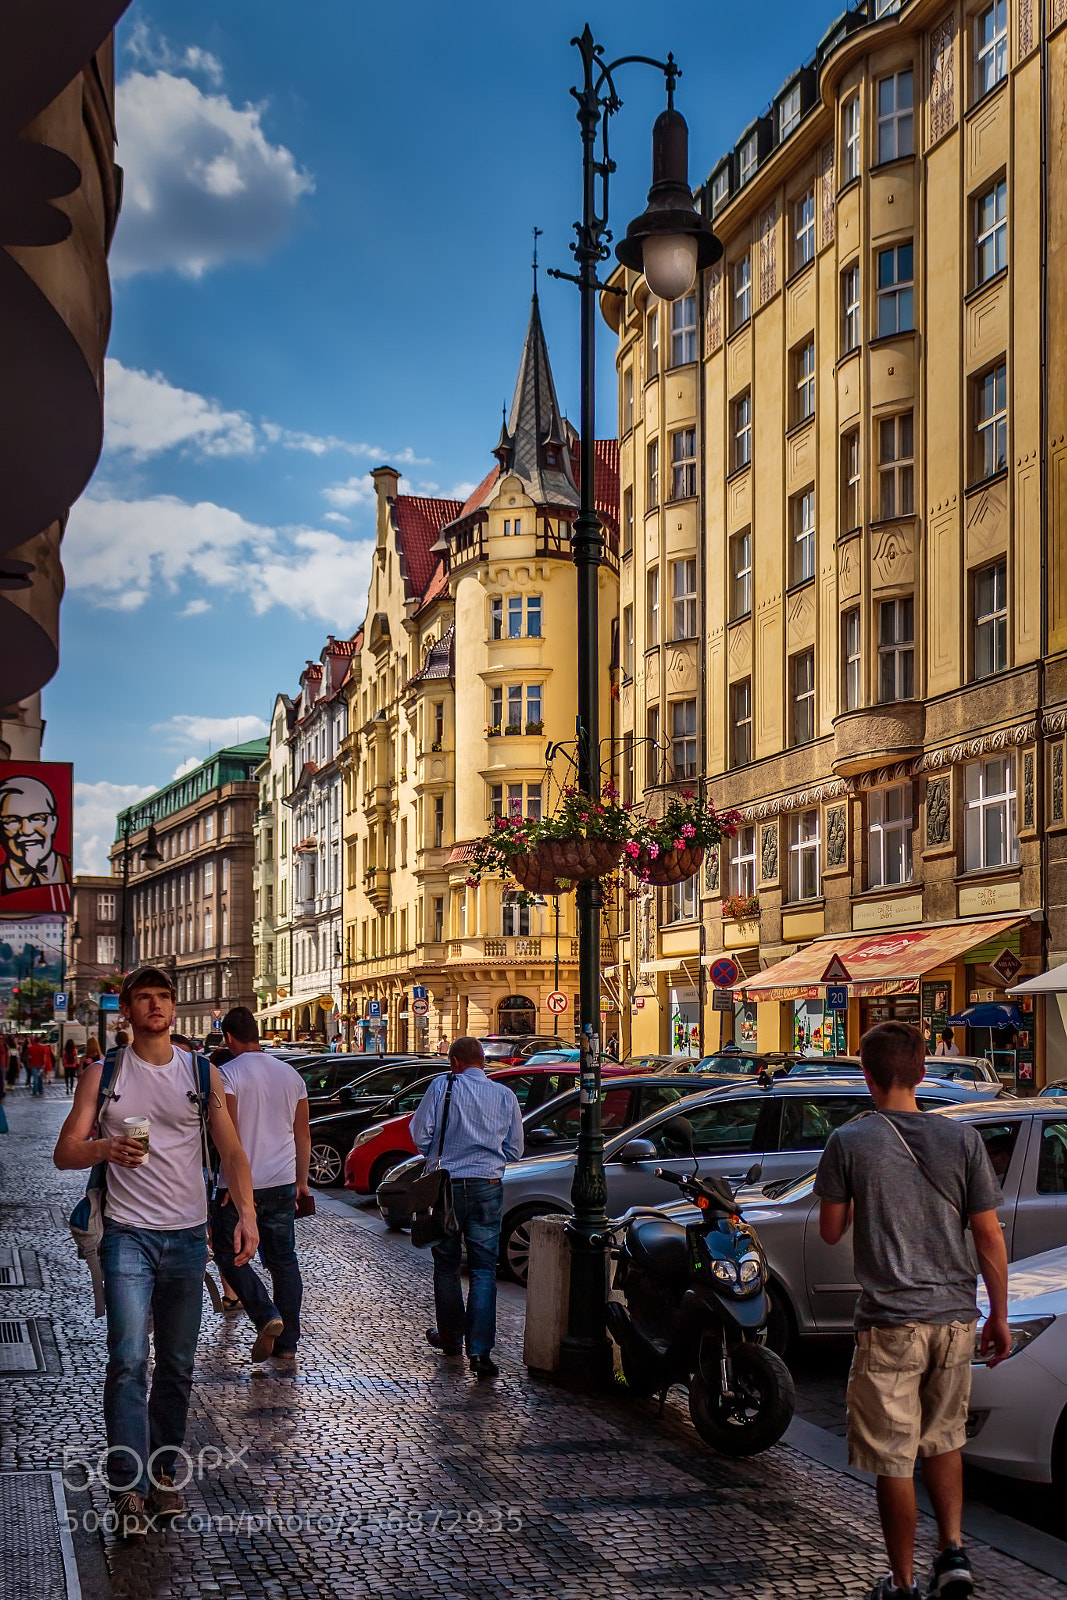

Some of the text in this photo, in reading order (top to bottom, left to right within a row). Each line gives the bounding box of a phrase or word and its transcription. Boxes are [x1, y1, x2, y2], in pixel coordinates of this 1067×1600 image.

[56, 995, 65, 1005] P
[831, 992, 844, 1004] 20
[371, 1003, 379, 1013] P
